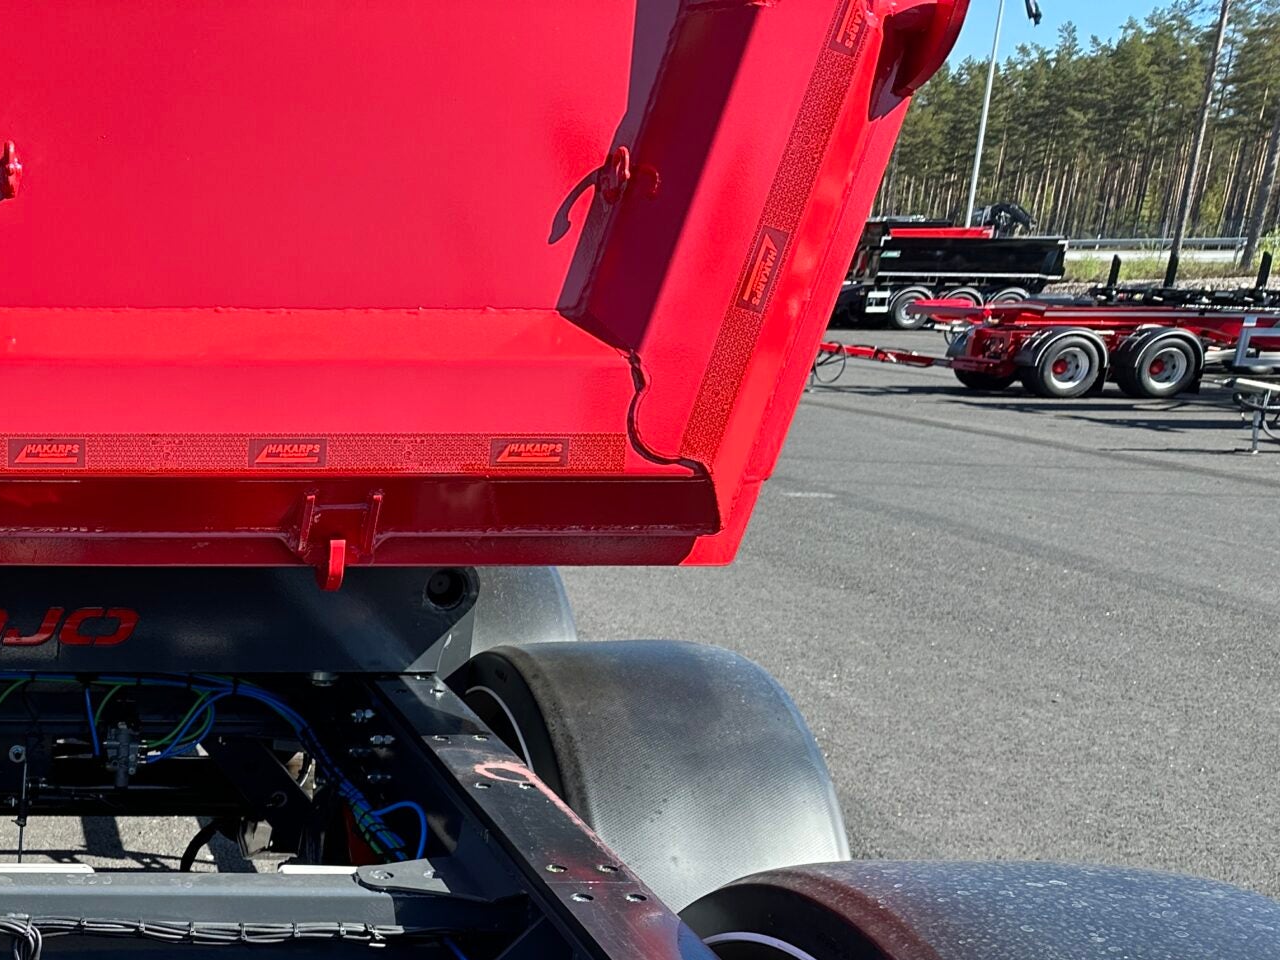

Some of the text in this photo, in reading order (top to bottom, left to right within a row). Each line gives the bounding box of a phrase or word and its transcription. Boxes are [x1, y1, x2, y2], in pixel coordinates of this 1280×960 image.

[751, 248, 778, 306] HAKARPS
[26, 444, 80, 454] HAKARPS
[267, 443, 321, 453] HAKARPS
[509, 443, 563, 453] HAKARPS
